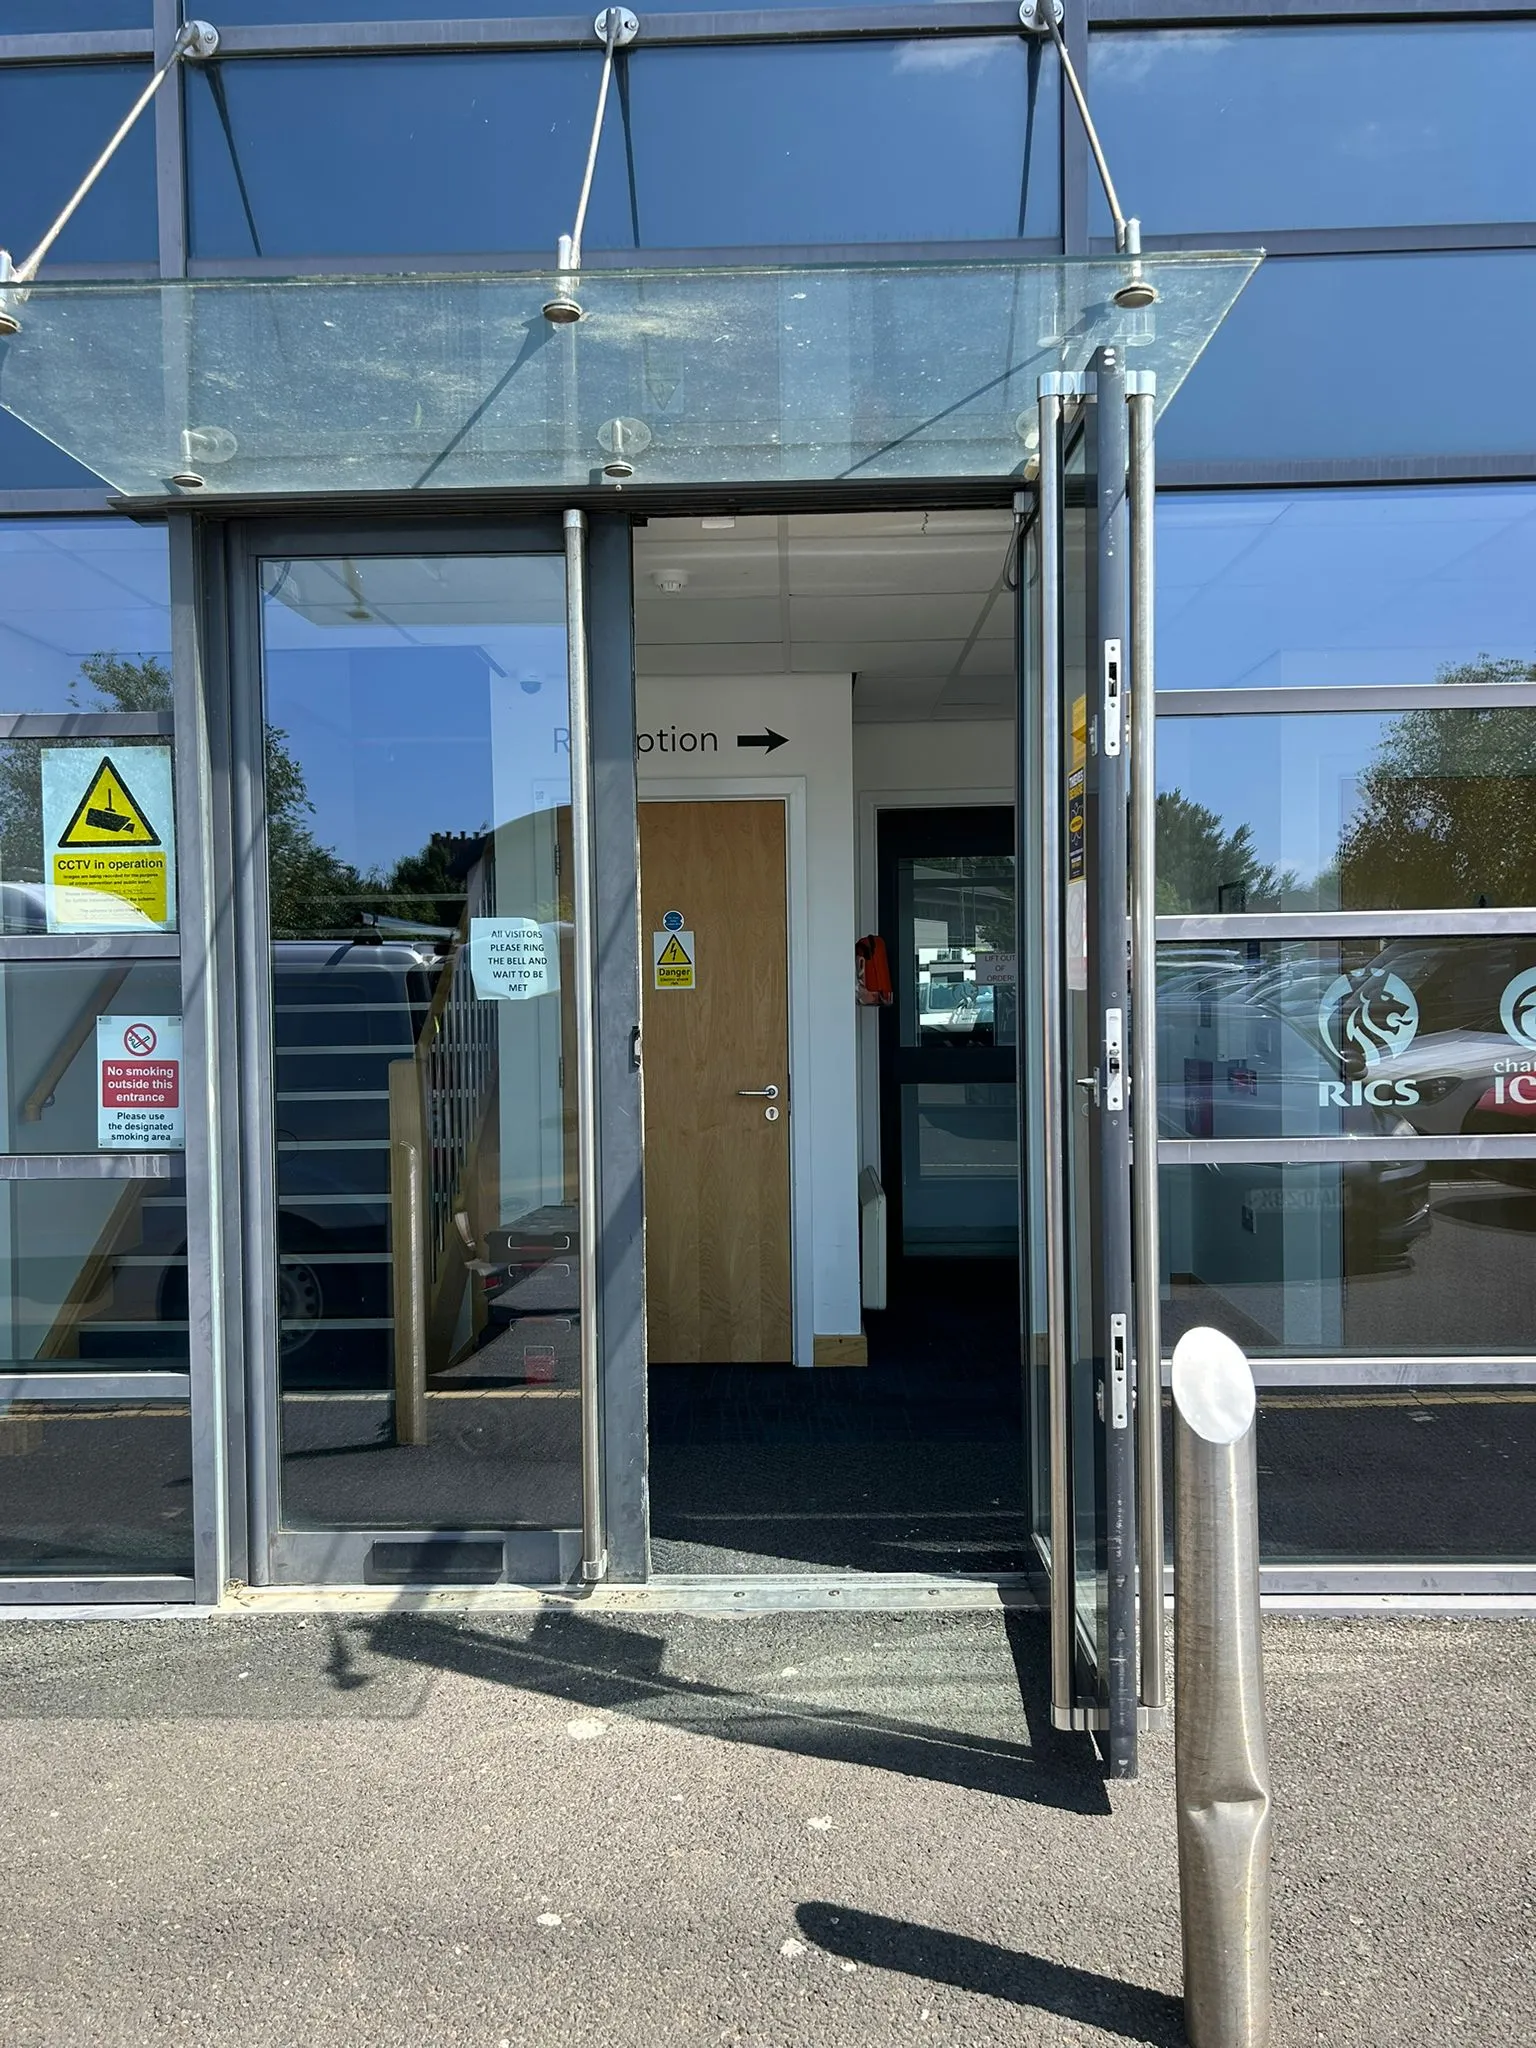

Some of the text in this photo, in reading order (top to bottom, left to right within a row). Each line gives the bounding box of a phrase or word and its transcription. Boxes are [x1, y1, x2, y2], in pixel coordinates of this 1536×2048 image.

[553, 725, 718, 760] Rption
[58, 858, 163, 871] CCTV in operation
[504, 930, 543, 938] VISITORS
[490, 944, 545, 952] PLEASE RING
[488, 957, 548, 965] THE BELL AND
[492, 970, 544, 978] WAIT TO BE
[658, 968, 691, 977] Danger
[508, 984, 528, 992] MET
[107, 1066, 174, 1078] No smoking
[107, 1079, 173, 1089] outside this
[116, 1093, 165, 1102] entrance
[1319, 1079, 1420, 1107] RICS
[117, 1112, 147, 1120] Please
[124, 1122, 174, 1132] designated
[111, 1133, 149, 1142] smoking
